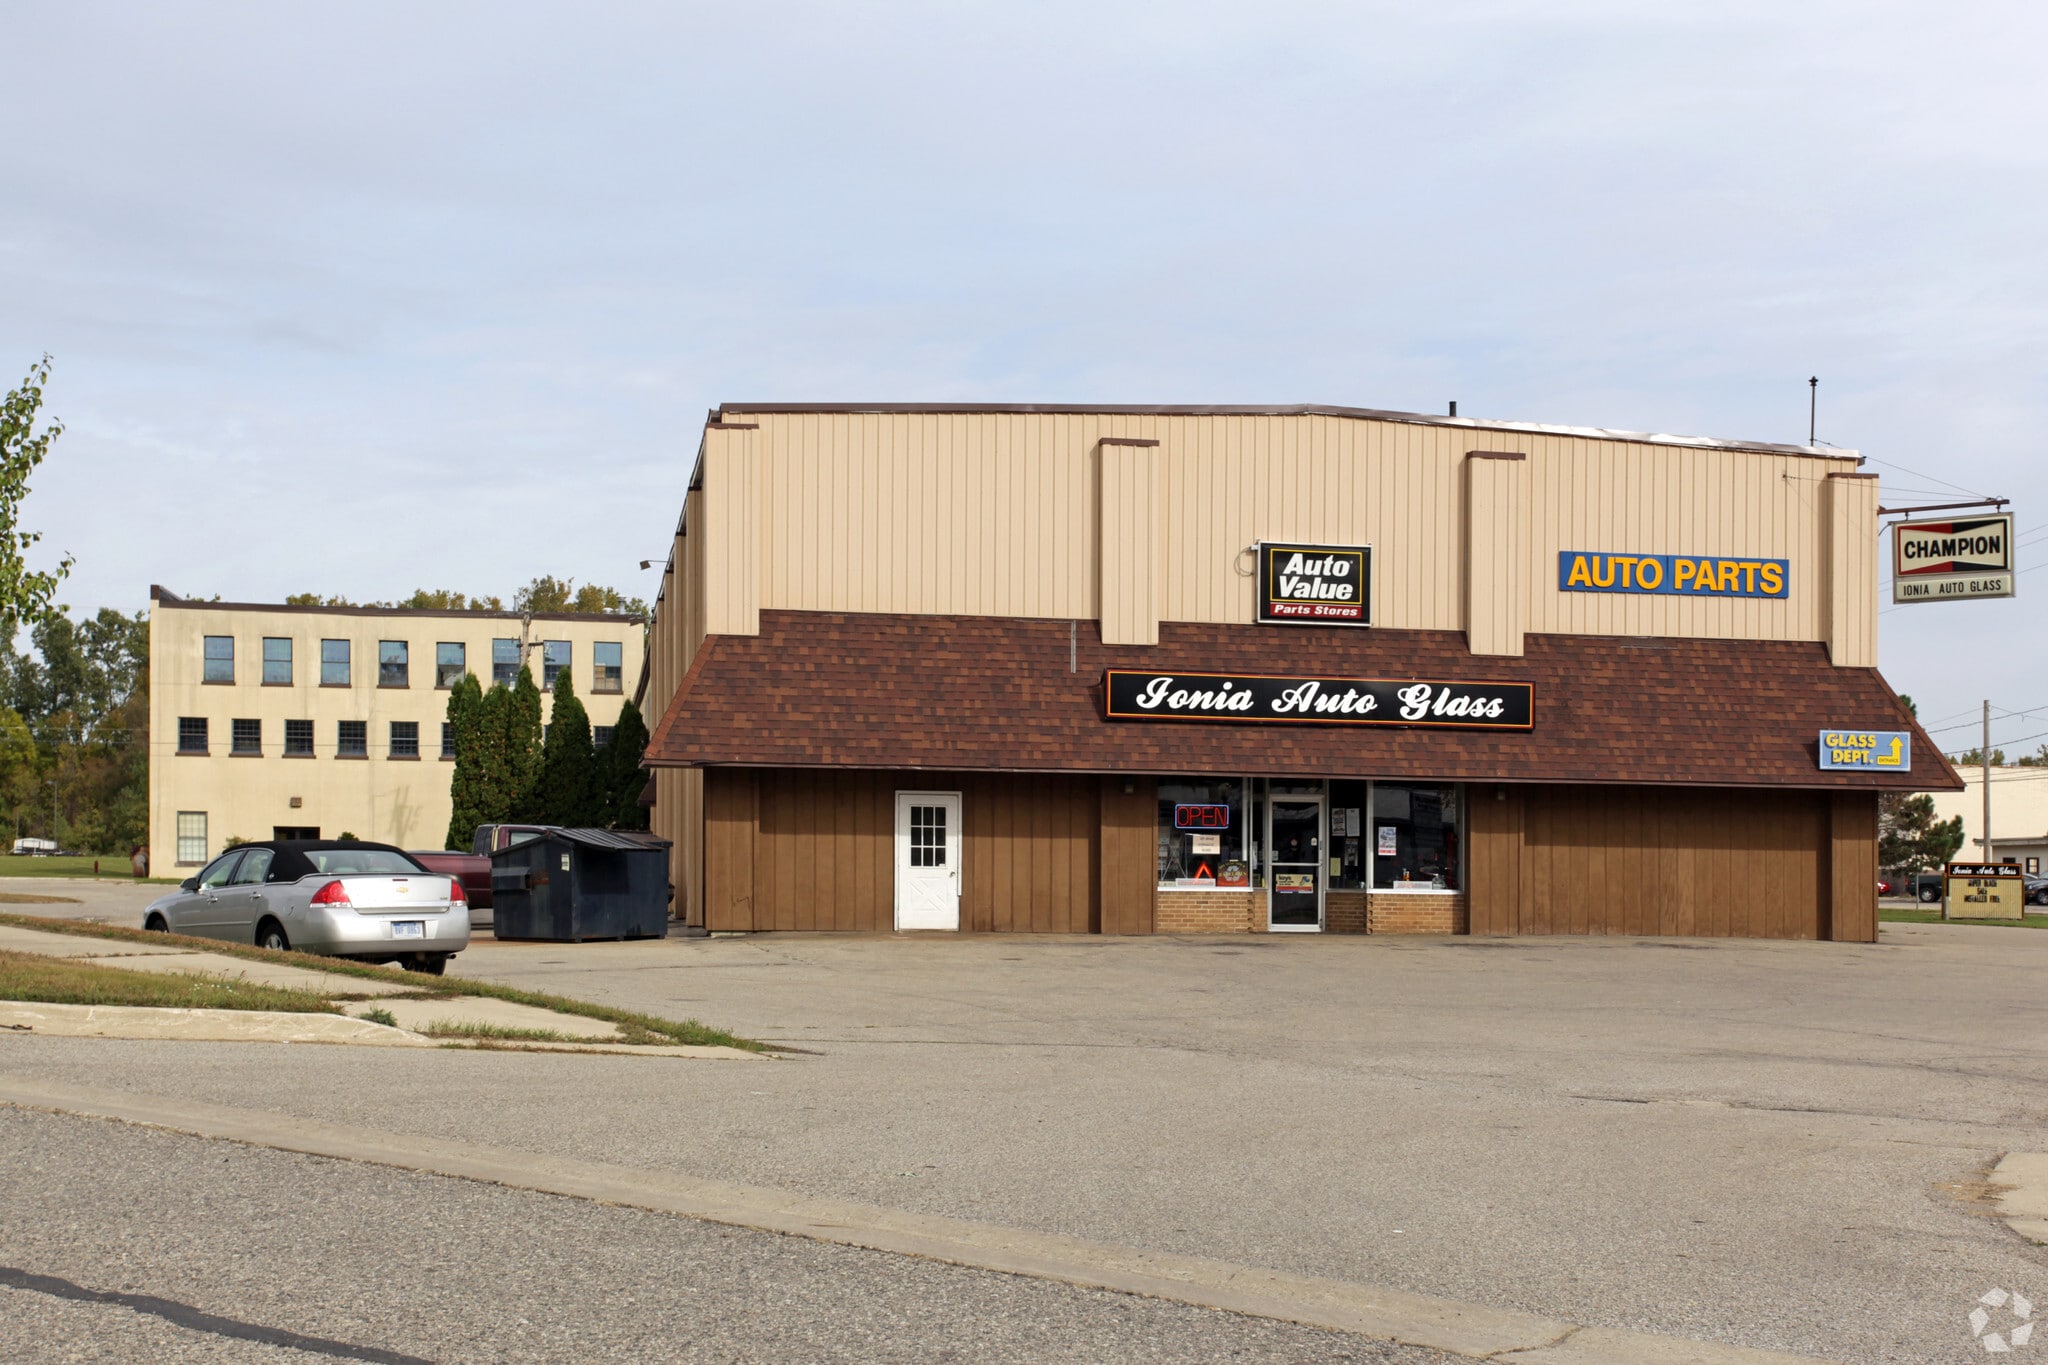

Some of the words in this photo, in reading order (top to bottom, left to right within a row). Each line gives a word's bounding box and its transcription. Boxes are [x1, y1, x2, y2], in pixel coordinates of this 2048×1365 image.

[1904, 535, 2000, 559] CHAMPION
[1282, 552, 1351, 577] Auto
[1566, 555, 1663, 590] AUTO
[1674, 558, 1784, 595] PARTS
[1278, 575, 1354, 600] Value
[1903, 584, 1930, 596] IONIA
[1939, 581, 1965, 594] AUTO
[1970, 579, 2002, 592] GLASS
[1273, 603, 1310, 616] Parts
[1314, 604, 1358, 618] Stores
[1136, 676, 1254, 711] Ionia
[1271, 681, 1378, 714] Auto
[1397, 683, 1504, 721] Glass
[1825, 733, 1877, 748] GLASS
[1832, 749, 1874, 764] DEPT.
[1177, 806, 1227, 827] OPEN
